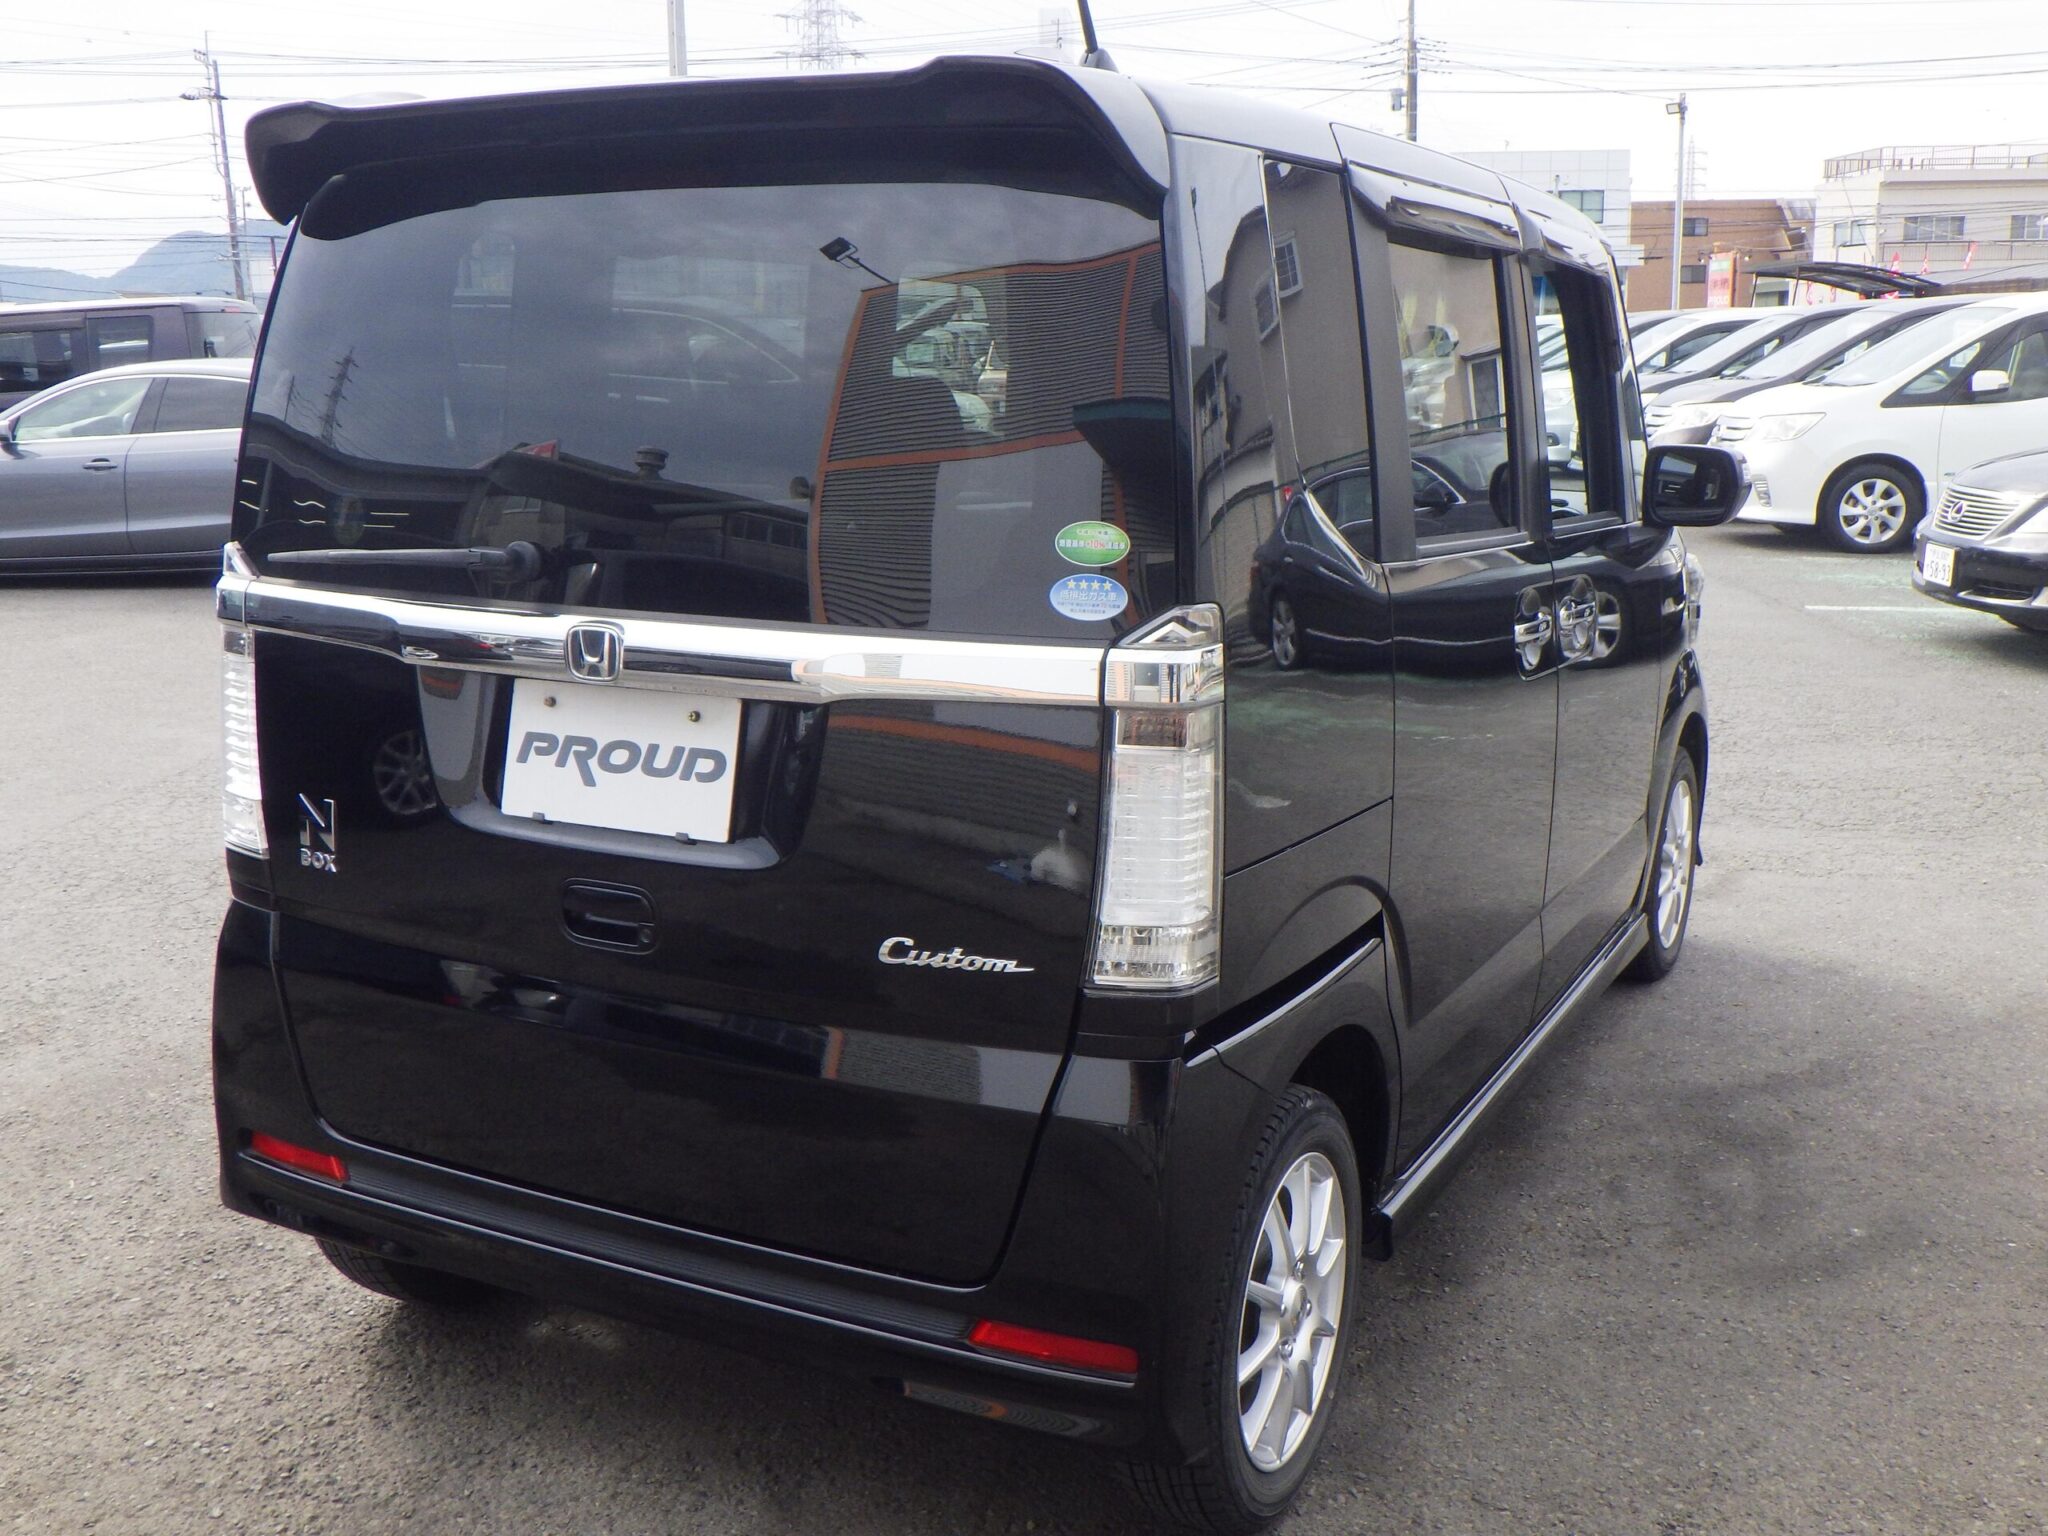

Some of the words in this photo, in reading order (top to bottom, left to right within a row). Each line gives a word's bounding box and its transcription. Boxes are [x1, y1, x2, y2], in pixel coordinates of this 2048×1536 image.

[515, 731, 728, 788] PROUD
[298, 792, 336, 852] N
[299, 848, 337, 873] BOX
[878, 936, 1035, 973] Custom
